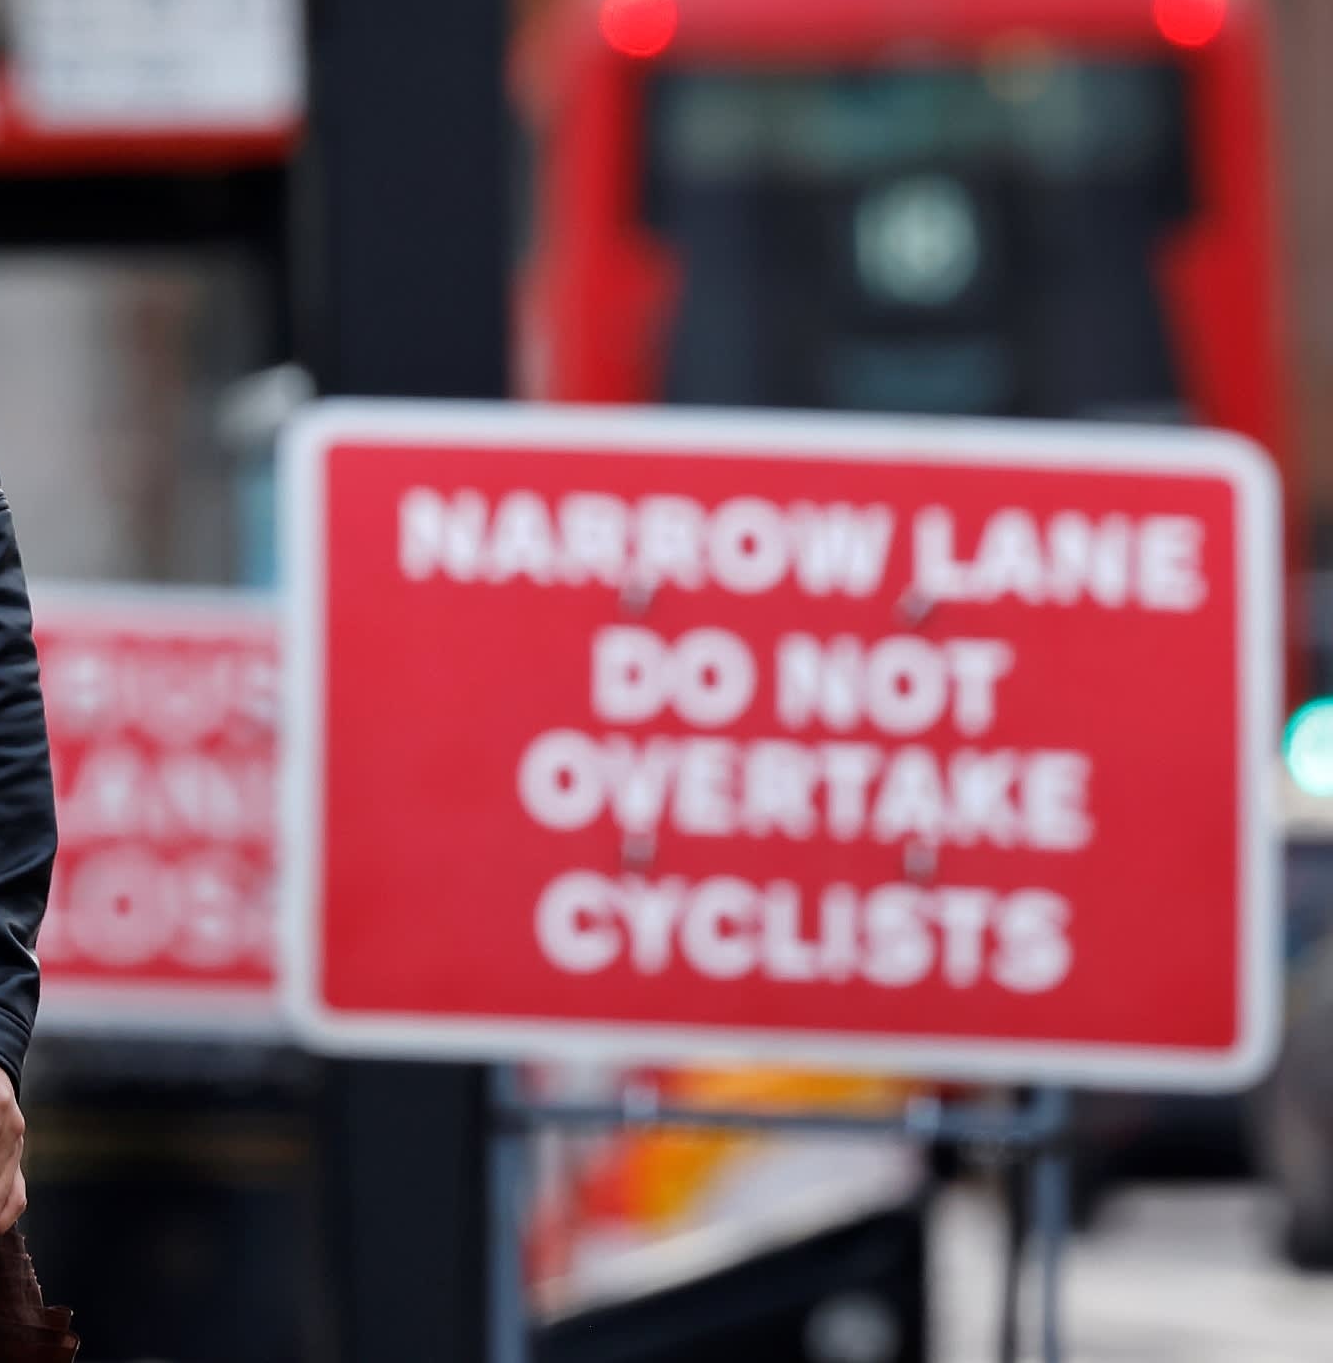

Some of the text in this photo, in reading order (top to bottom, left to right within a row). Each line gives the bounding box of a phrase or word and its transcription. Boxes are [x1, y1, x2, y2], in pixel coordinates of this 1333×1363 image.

[399, 488, 1208, 611] NARROW LANE
[592, 625, 1014, 735] DO NOT
[518, 729, 1093, 850] OVERTAKE
[535, 871, 1072, 992] CYCLISTS
